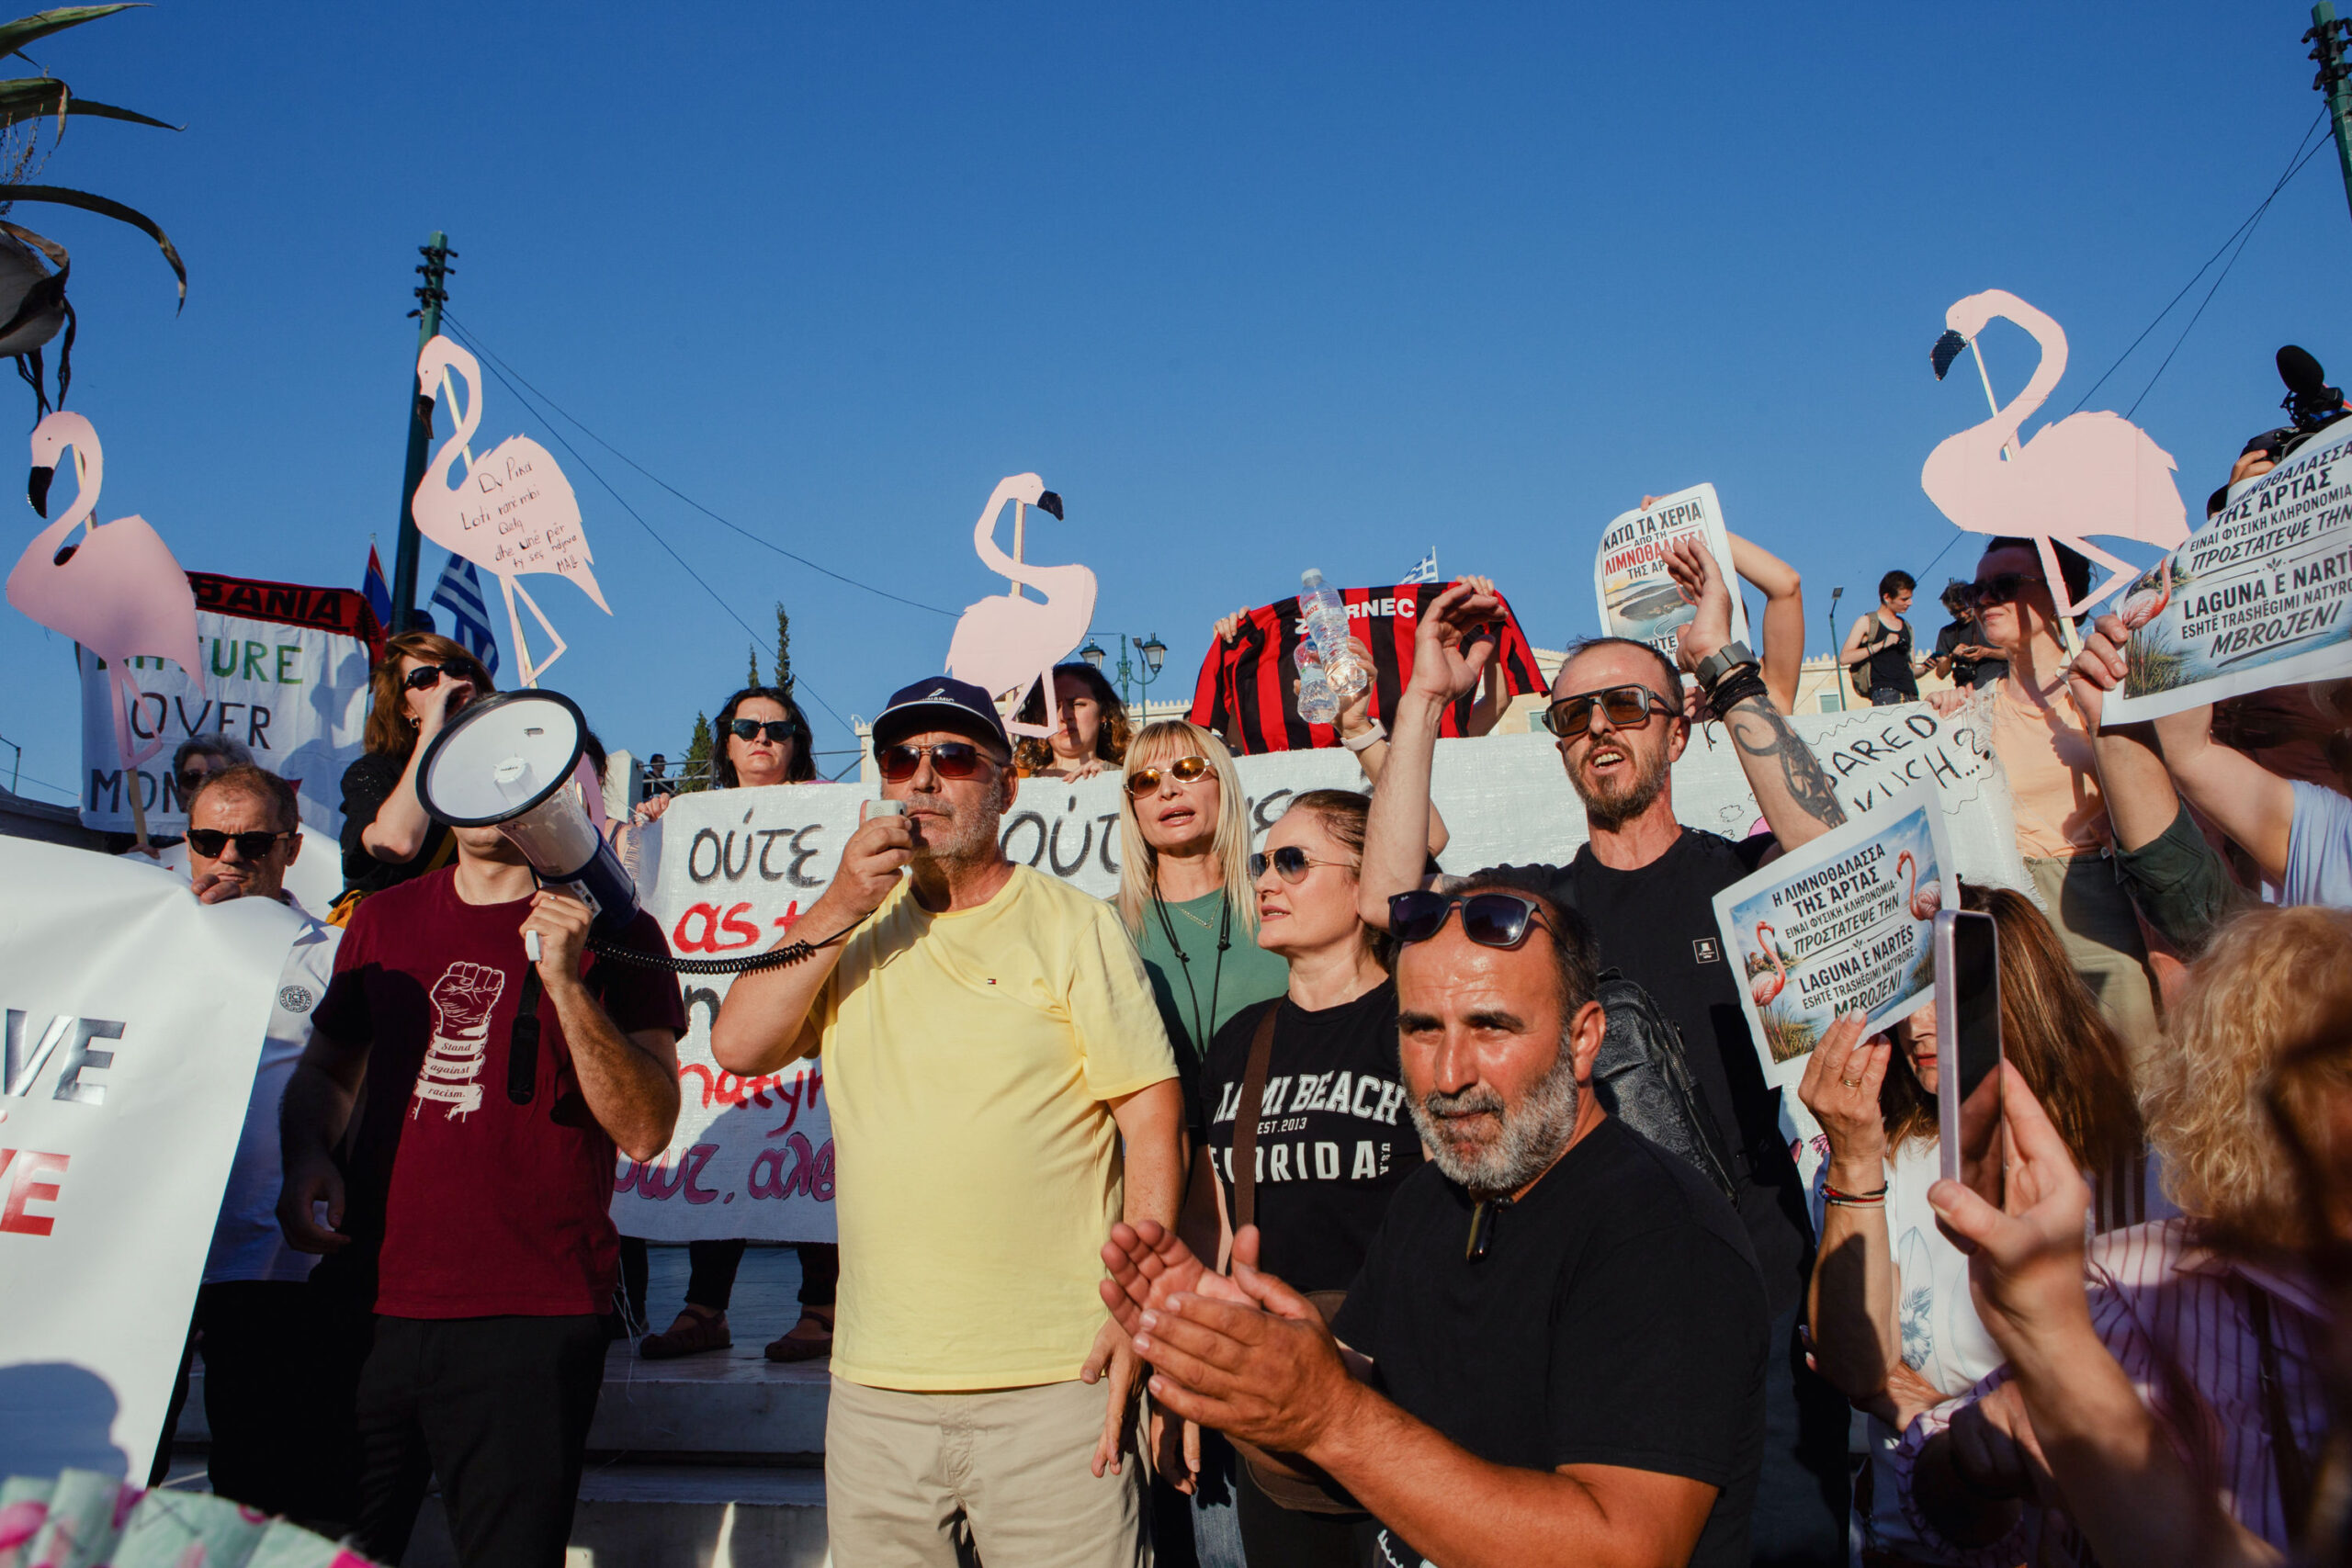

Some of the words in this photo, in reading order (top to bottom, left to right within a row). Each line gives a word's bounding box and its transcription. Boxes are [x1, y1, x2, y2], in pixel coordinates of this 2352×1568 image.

[478, 473, 503, 493] Dy
[506, 457, 533, 481] Pika
[461, 506, 491, 530] Loti
[520, 484, 540, 505] mbi
[1603, 524, 1635, 553] ΚΑΤΩ
[1636, 514, 1657, 536] ΤΑ
[1657, 502, 1702, 530] ΧΕΡΙΑ
[2215, 498, 2253, 528] ΤΗΣ
[495, 544, 514, 562] dhe
[1634, 536, 1653, 547] ΑΠΟ
[1654, 530, 1668, 540] ΤΗ
[2189, 533, 2219, 553] ΕΙΝΑΙ
[2222, 516, 2267, 541] ΦΥΣΙΚΗ
[2191, 517, 2312, 572] ΠΡΟΣΤΑΤΕΨΕ
[1627, 564, 1648, 580] ΤΗΣ
[2181, 614, 2219, 639] ESHTË
[2222, 593, 2300, 628] TRASHËGIMI
[2184, 579, 2267, 620] LAGUNA
[2274, 573, 2287, 595] E
[2210, 600, 2344, 659] MBROJENI
[130, 691, 272, 750] OVER
[1817, 714, 1938, 790] ARED
[1771, 893, 1783, 908] Η
[1784, 843, 1886, 903] ΛΙΜΝΟΘΑΛΑΣΣΑ
[673, 901, 762, 953] as
[1784, 921, 1809, 939] ΕΙΝΑΙ
[1810, 906, 1844, 929] ΦΥΣΙΚΗ
[1792, 891, 1827, 919] ΤΗΣ
[1793, 906, 1876, 956] ΠΡΟΣΤΑΤΕΨΕ
[1877, 893, 1900, 917] ΤΗΝ
[1799, 956, 1862, 994] LAGUNA
[1861, 950, 1872, 969] E
[1871, 925, 1915, 964] NARTËS
[1802, 987, 1834, 1010] ESHTË
[1833, 968, 1883, 998] TRASHËGIMI
[4, 1009, 127, 1106] VE
[430, 1065, 470, 1075] against
[441, 1043, 472, 1051] Stand
[427, 1088, 467, 1098] racism.
[1288, 1069, 1407, 1126] BEACH
